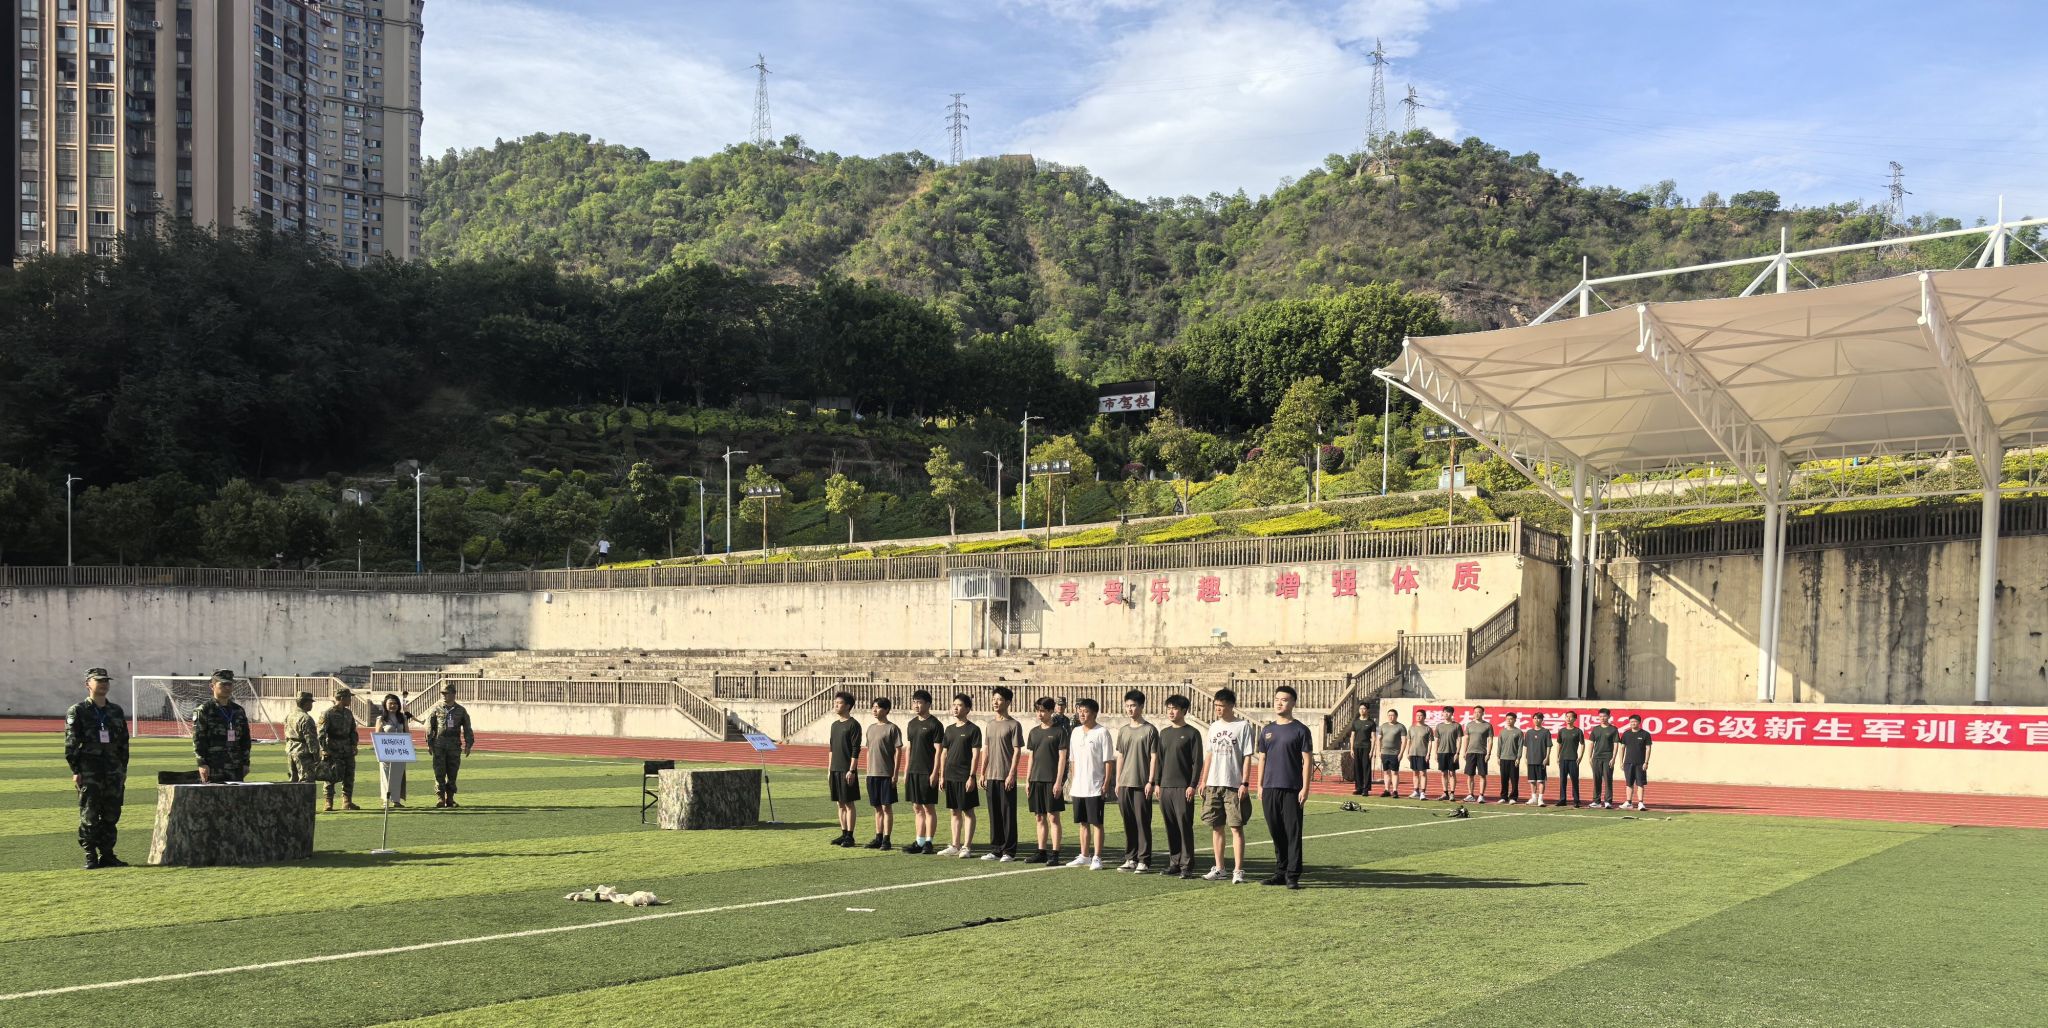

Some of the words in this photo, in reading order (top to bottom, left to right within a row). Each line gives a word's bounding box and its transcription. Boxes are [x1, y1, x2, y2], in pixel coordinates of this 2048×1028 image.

[1058, 576, 1222, 606] 享受乐趣
[1275, 561, 1482, 599] 增强体质
